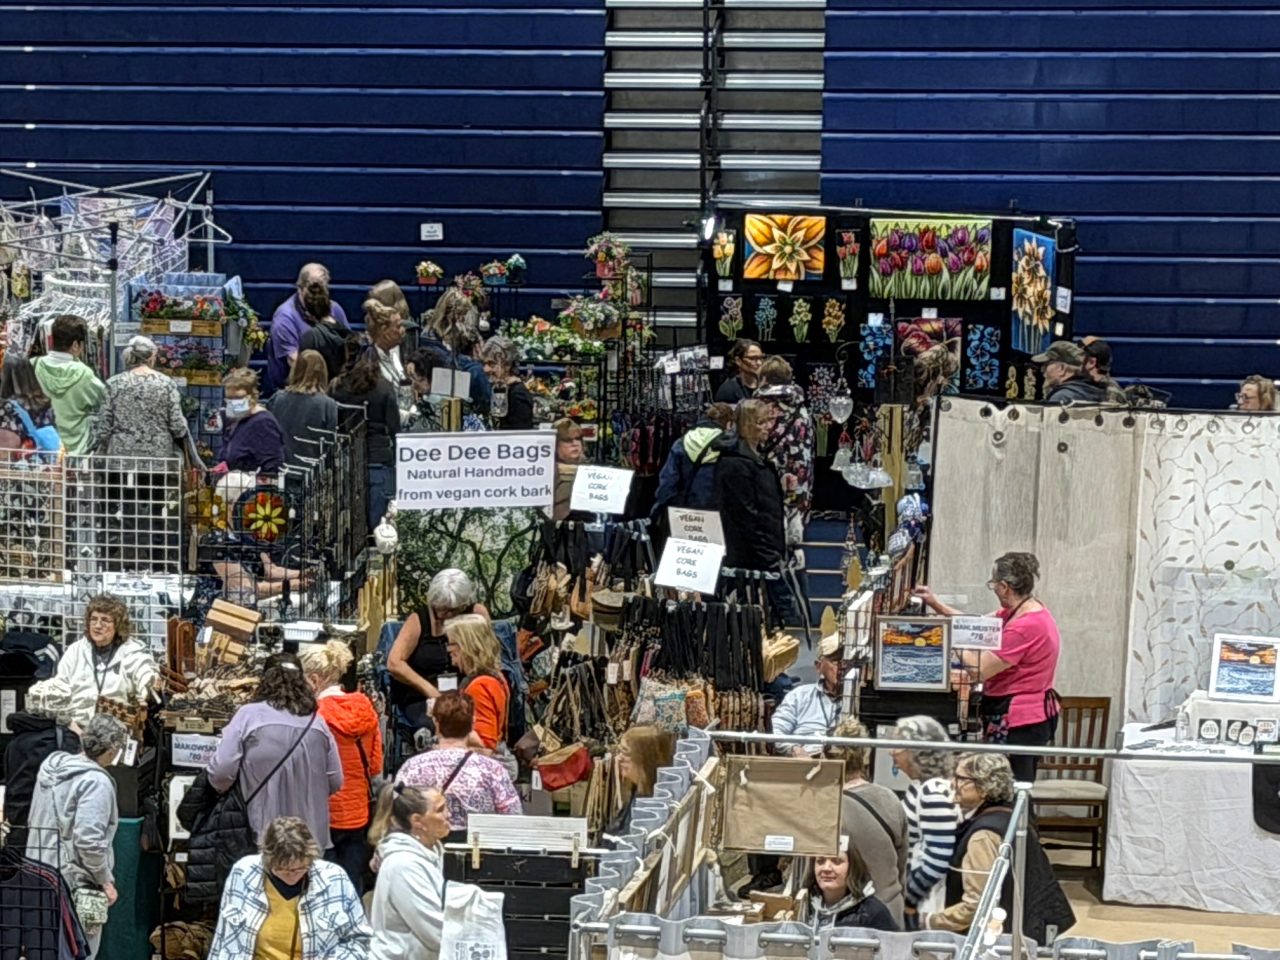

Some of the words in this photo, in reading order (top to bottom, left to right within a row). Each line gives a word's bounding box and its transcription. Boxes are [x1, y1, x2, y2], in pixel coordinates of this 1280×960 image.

[399, 447, 442, 463] Dee
[448, 445, 490, 461] Dee
[497, 443, 551, 464] Bags
[407, 466, 460, 480] Natural
[464, 464, 544, 478] Handmade
[398, 488, 432, 501] from
[436, 489, 481, 502] vegan
[484, 487, 517, 498] cork
[521, 485, 551, 497] bark
[679, 514, 705, 523] VEGAN
[676, 546, 705, 556] VEGAN
[676, 568, 698, 579] BAGS
